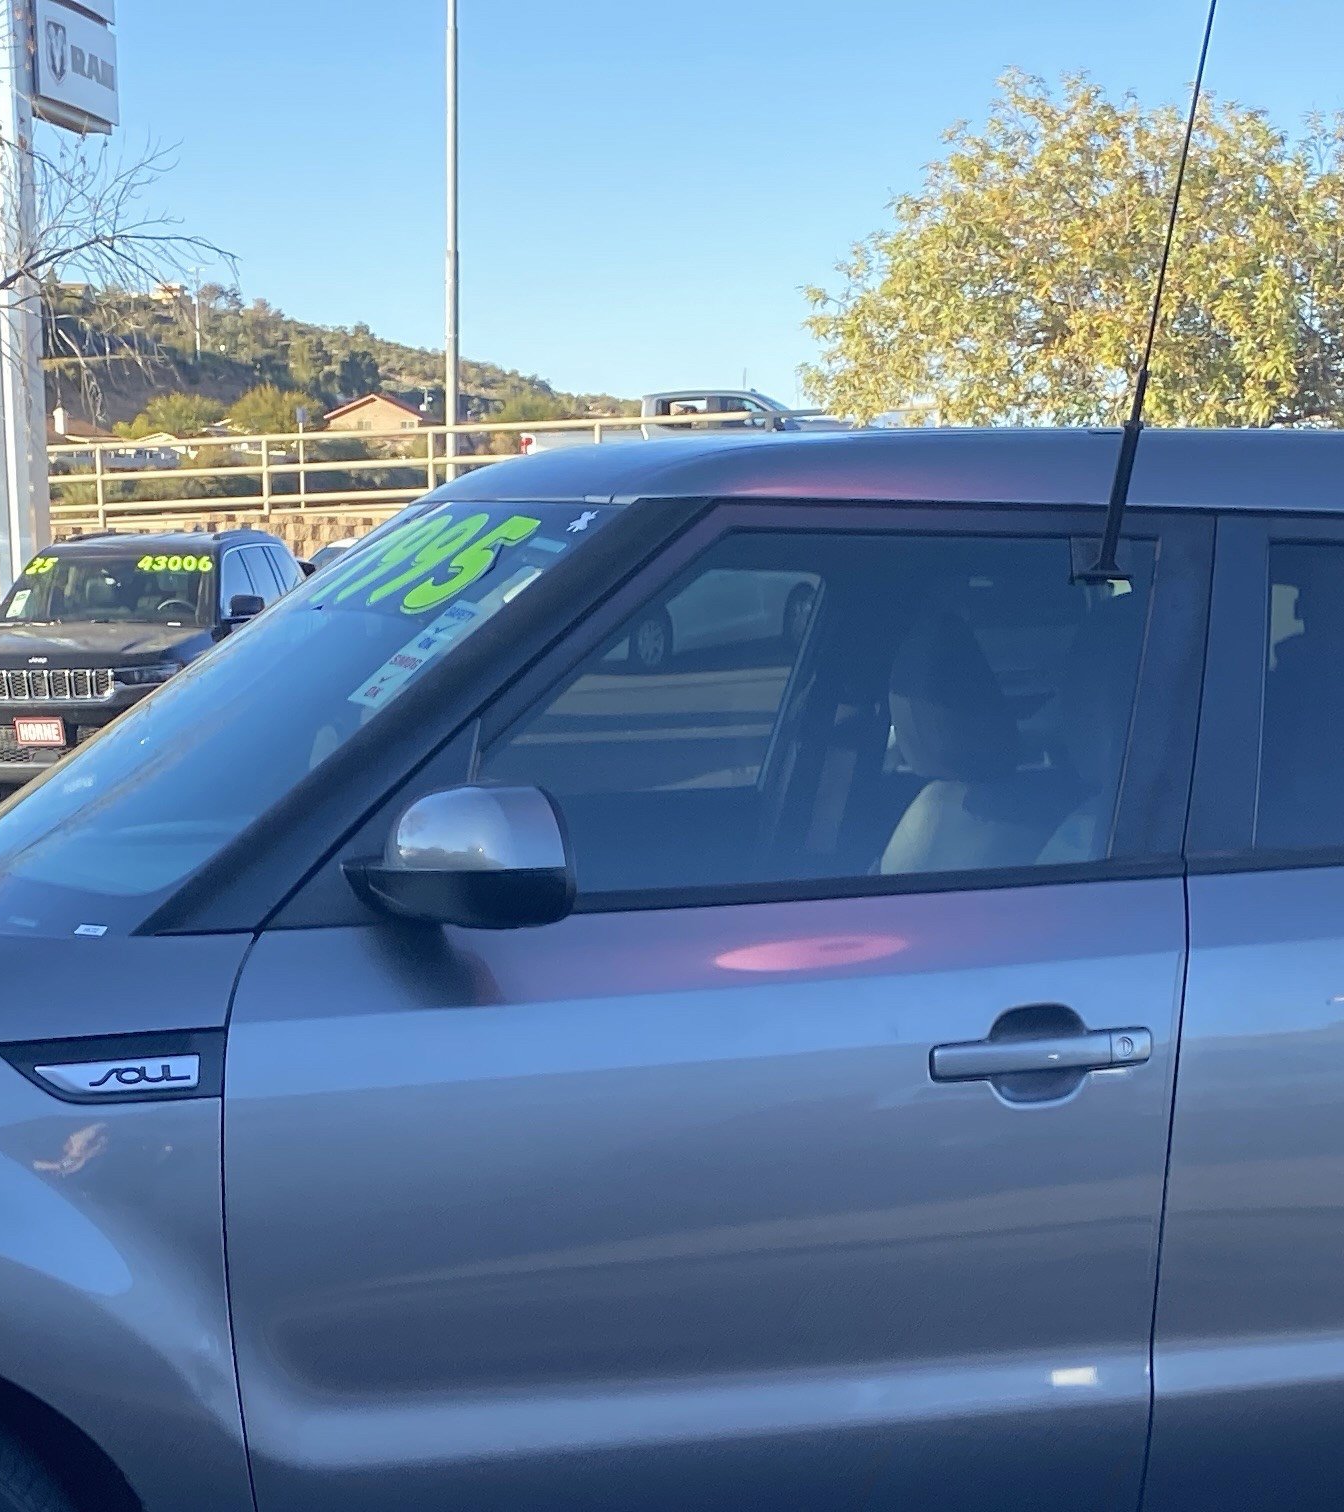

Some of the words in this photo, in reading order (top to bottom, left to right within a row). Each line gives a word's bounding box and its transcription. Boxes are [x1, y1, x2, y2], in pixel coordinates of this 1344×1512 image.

[71, 45, 115, 91] RAM
[25, 556, 58, 575] 25
[137, 555, 213, 572] 43006
[19, 723, 61, 741] HORNE
[89, 1064, 191, 1087] SOUL
